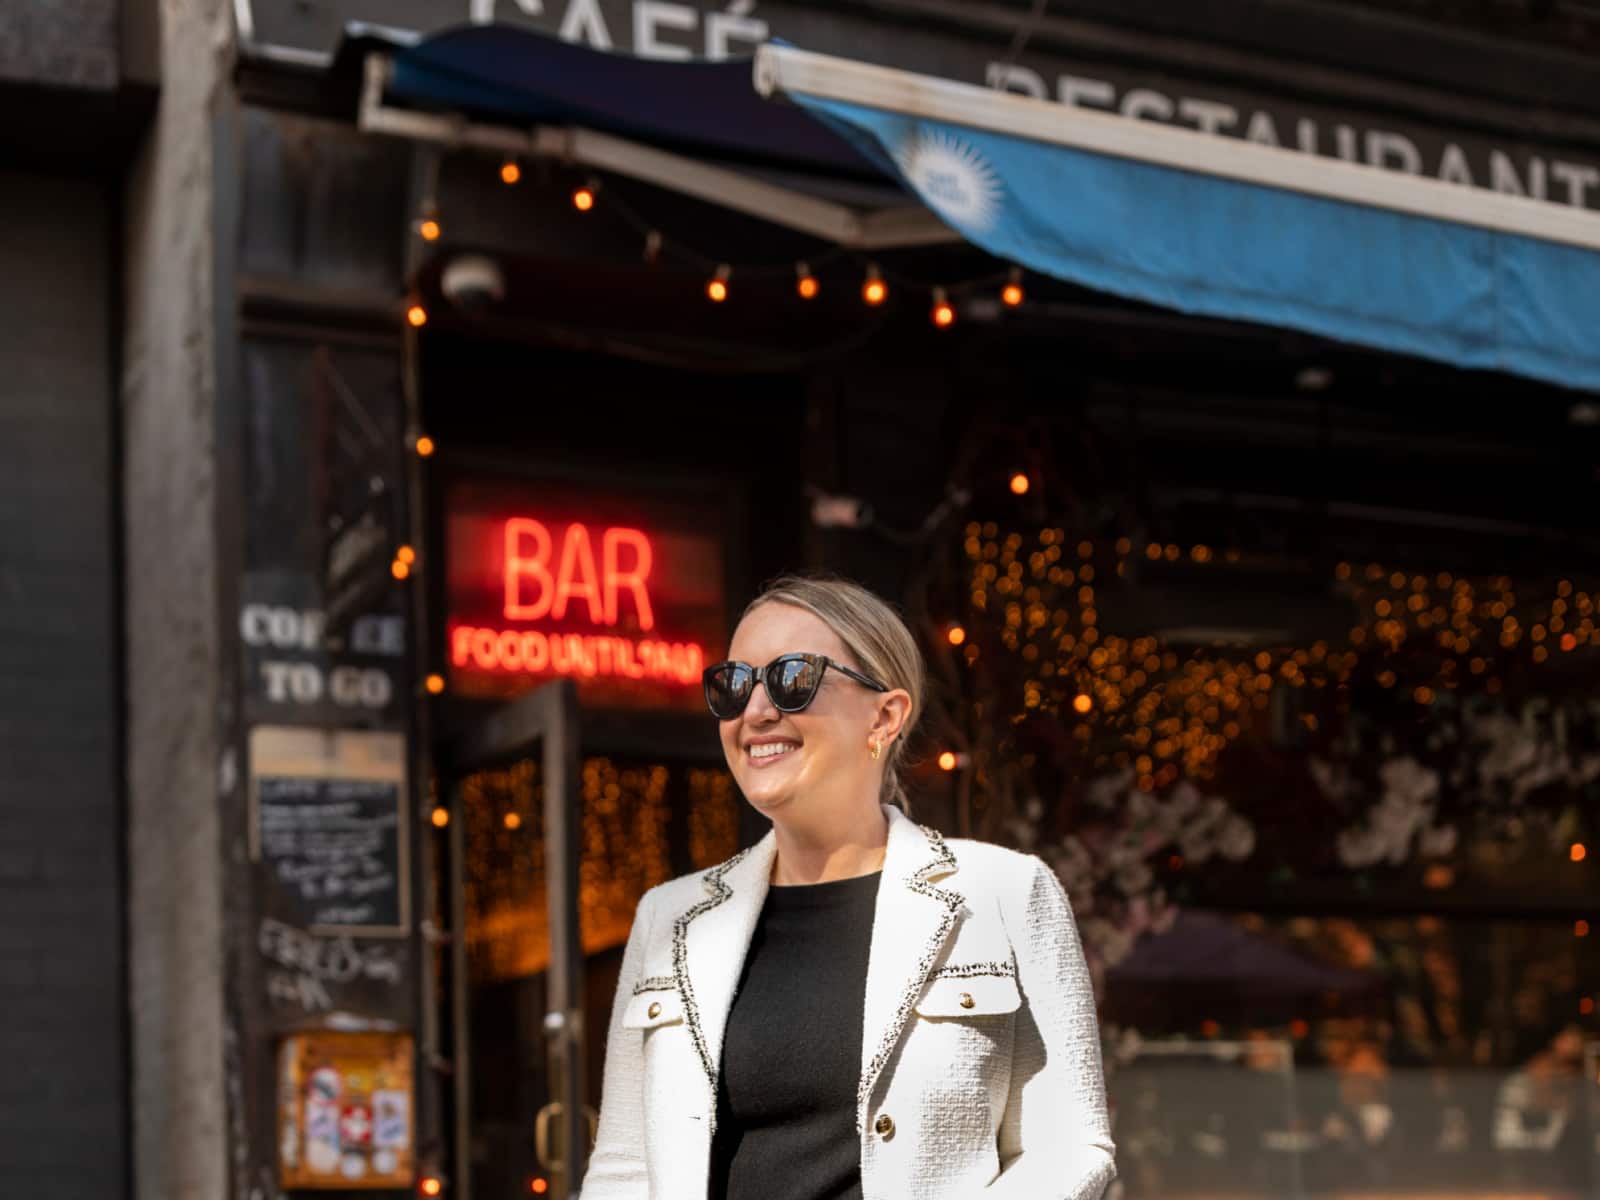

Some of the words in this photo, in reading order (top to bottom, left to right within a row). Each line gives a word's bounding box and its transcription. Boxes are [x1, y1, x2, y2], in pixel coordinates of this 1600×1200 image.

[470, 0, 769, 61] AFÉ
[504, 517, 654, 630] BAR
[240, 603, 405, 656] COFEE
[452, 626, 548, 672] FOOD
[259, 660, 323, 703] TO
[329, 665, 392, 708] GO
